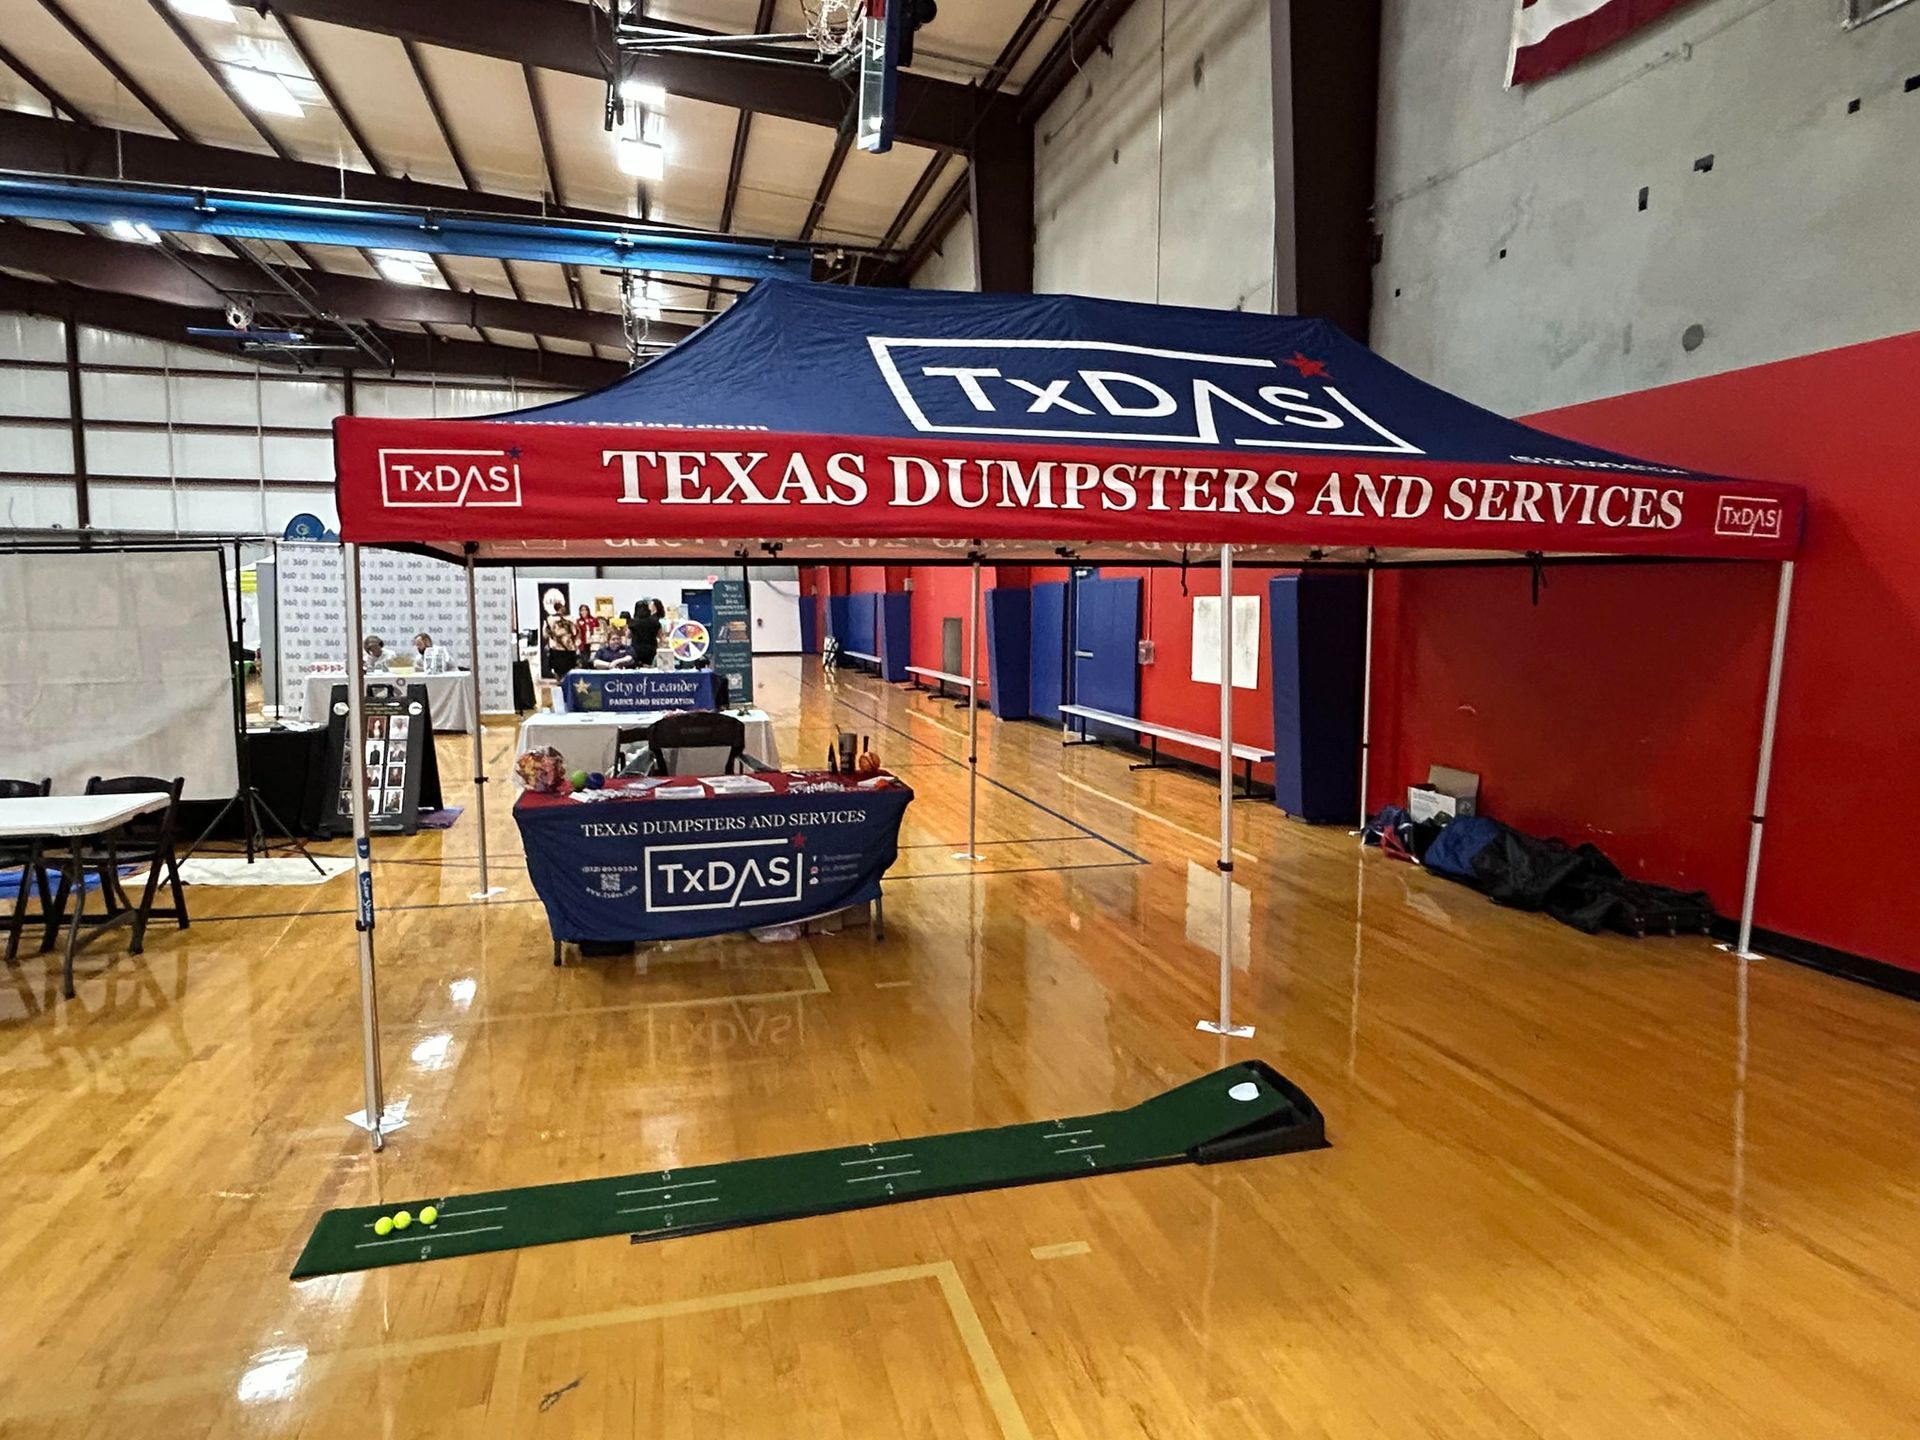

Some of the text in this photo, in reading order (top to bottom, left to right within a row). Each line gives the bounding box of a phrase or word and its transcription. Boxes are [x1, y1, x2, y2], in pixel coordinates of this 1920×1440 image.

[921, 367, 1344, 442] TxDAS
[391, 465, 510, 501] TxDAS
[603, 450, 1684, 530] TEXAS DUMPSTERS AND SERVICES
[1722, 506, 1777, 532] TxDAS
[604, 677, 699, 696] City of Leander
[609, 698, 633, 706] PARKS
[581, 809, 866, 837] TEXAS DUMPSTERS AND SERVICES
[657, 856, 790, 904] TxDAS
